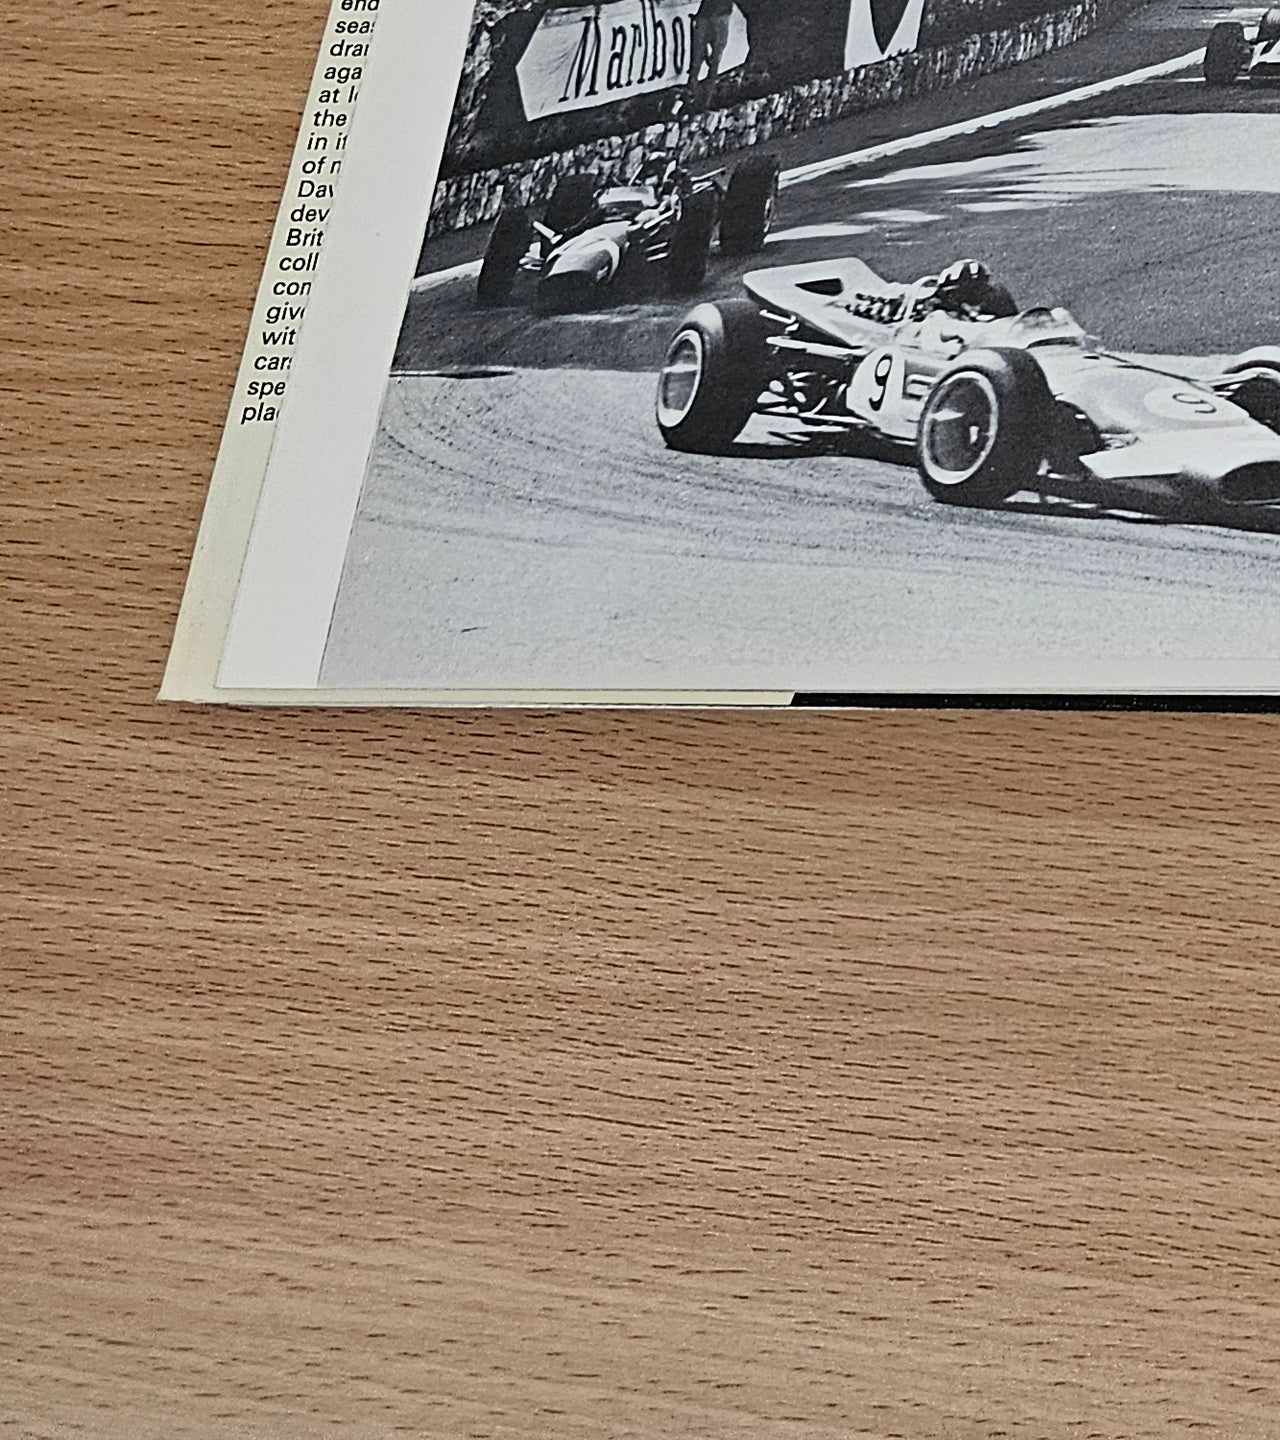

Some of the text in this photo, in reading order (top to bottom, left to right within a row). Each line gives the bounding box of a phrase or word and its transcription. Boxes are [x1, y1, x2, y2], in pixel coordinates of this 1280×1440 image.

[318, 87, 341, 104] at
[313, 110, 347, 128] the
[306, 133, 328, 150] in
[302, 157, 327, 175] of
[290, 204, 330, 222] dev
[285, 228, 324, 247] Brit
[278, 252, 319, 272] coll
[262, 326, 297, 346] wit
[247, 380, 286, 397] spe
[868, 353, 893, 411] 9
